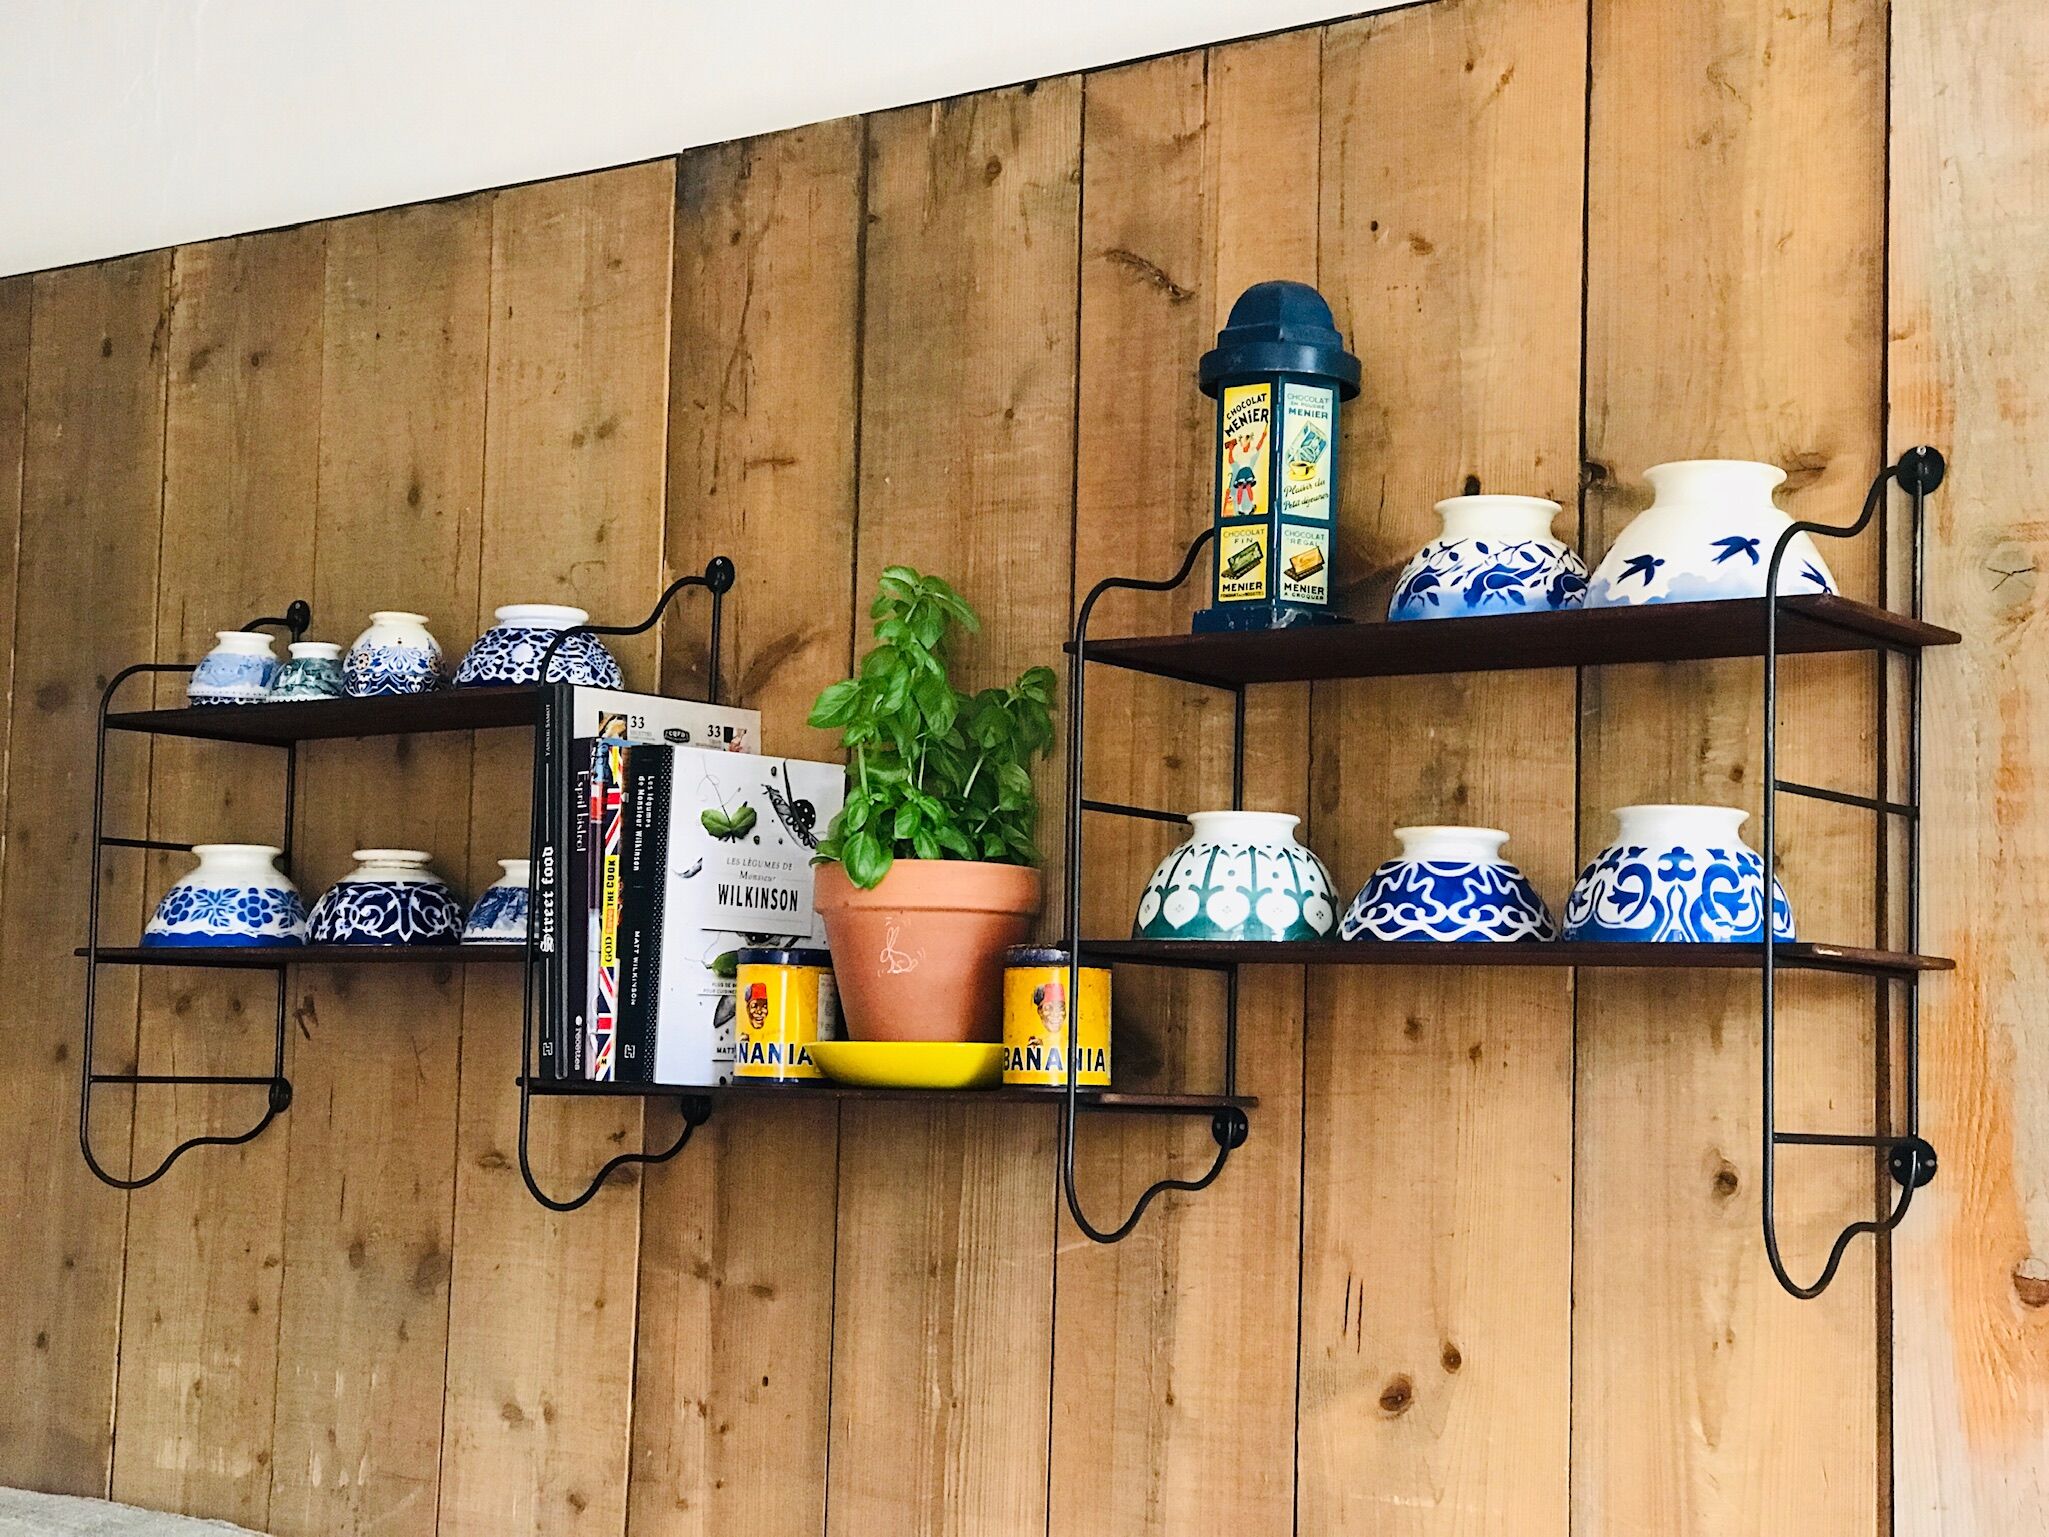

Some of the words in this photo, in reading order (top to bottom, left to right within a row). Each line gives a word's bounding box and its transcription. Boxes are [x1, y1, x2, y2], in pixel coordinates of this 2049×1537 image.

[1226, 392, 1267, 420] CHOCOLAT
[1287, 393, 1329, 404] CHOCOLAT
[1288, 407, 1329, 419] MENIER
[1222, 528, 1265, 538] CHOCOLAT
[1284, 529, 1325, 541] CHOCOLAT
[1222, 581, 1263, 592] MENIER
[1284, 582, 1325, 596] MENIER
[630, 715, 645, 729] 33
[707, 724, 721, 738] 33
[638, 775, 645, 786] de
[647, 775, 655, 790] Les
[635, 789, 645, 828] Monsieur
[645, 793, 655, 828] légumes
[633, 830, 643, 872] Wilkinson
[541, 846, 554, 885] food
[726, 857, 740, 866] LES
[742, 857, 780, 870] LÉGUMES
[783, 862, 793, 871] DE
[606, 860, 615, 888] COOK
[606, 891, 614, 907] THE
[718, 883, 798, 912] WILKINSON
[540, 891, 554, 953] Street
[630, 957, 639, 1006] WILKINSON
[734, 1043, 814, 1066] NANIA
